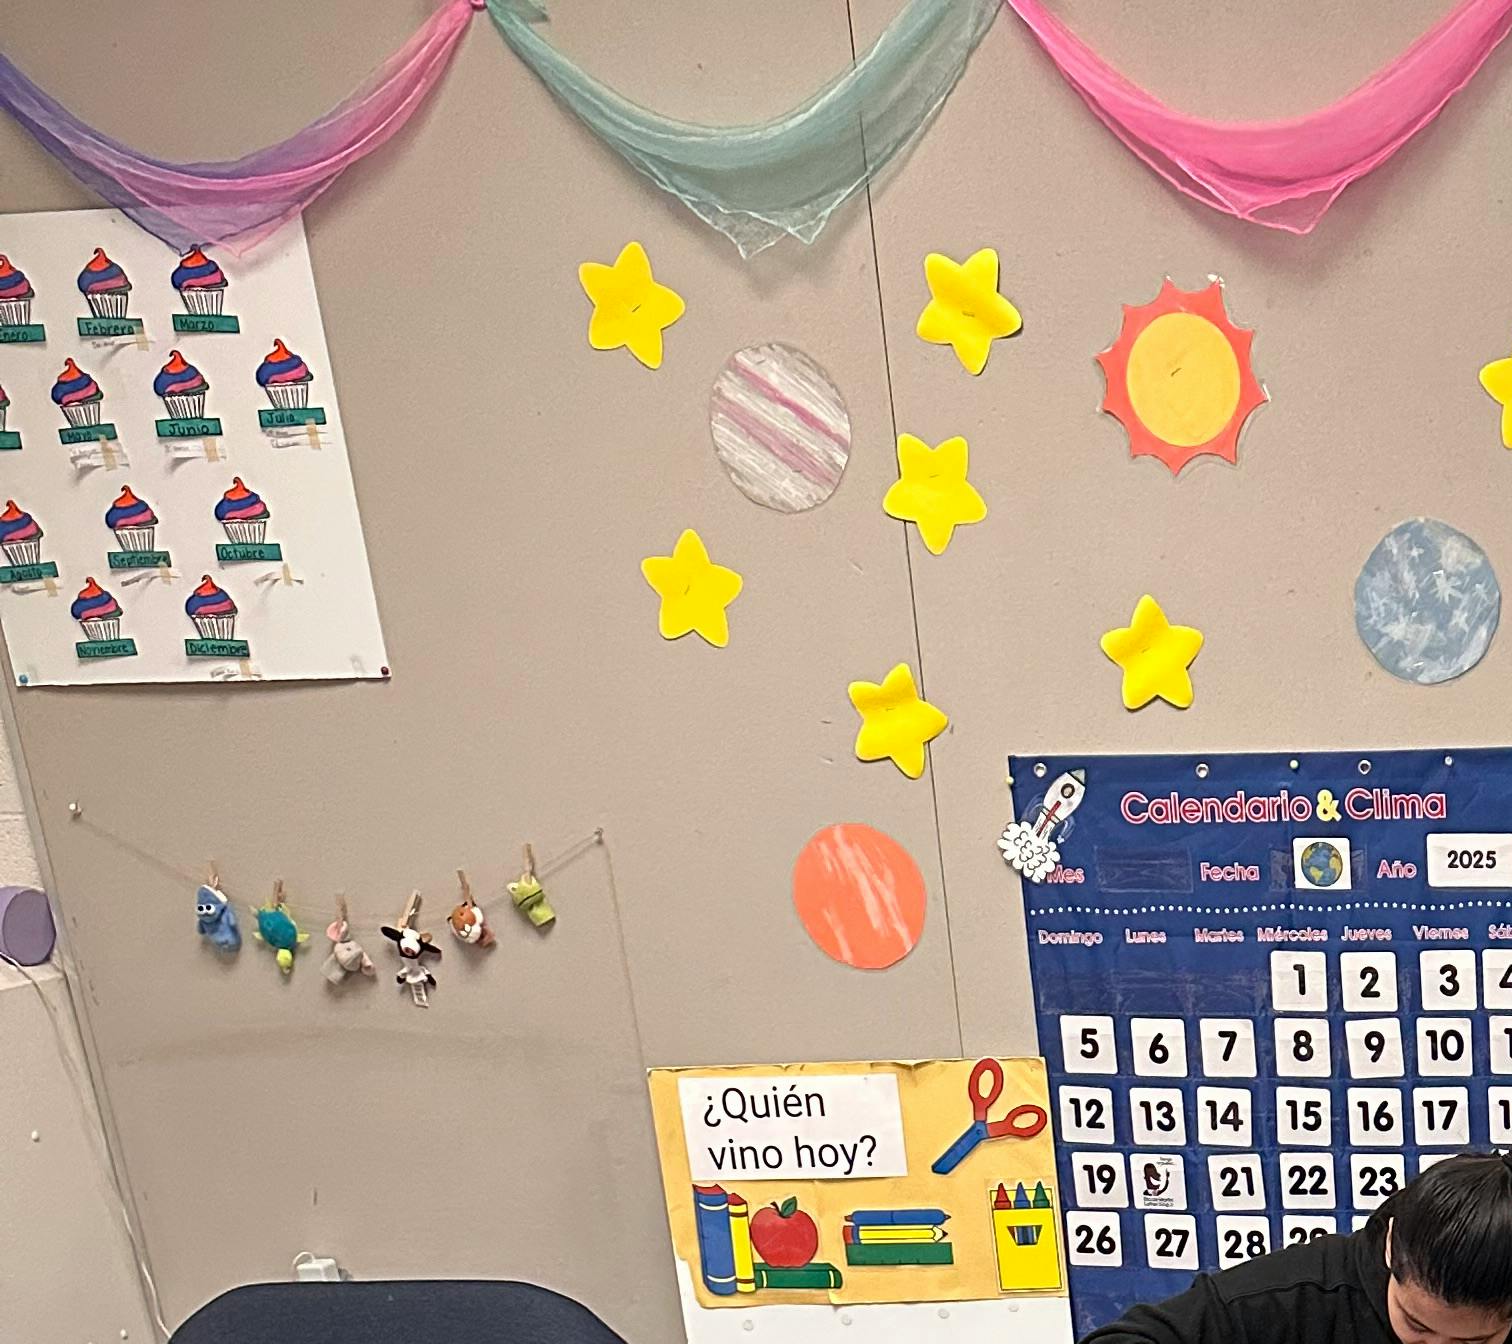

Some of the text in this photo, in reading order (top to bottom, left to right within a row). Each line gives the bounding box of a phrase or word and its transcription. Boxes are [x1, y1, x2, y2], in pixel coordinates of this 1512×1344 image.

[86, 321, 134, 336] Febrero
[179, 319, 214, 331] Marzo
[169, 424, 210, 435] Junio
[266, 412, 295, 424] Julio
[221, 548, 265, 560] Octubre
[1120, 787, 1447, 825] Calendario & Clima
[1377, 857, 1418, 880] Año
[1447, 849, 1497, 869] 2025
[1200, 861, 1260, 883] Fecha
[1038, 928, 1104, 947] Domingo
[1125, 928, 1167, 944] Lunes
[1194, 927, 1245, 943] Martes
[1257, 925, 1328, 942] Miércoles
[1341, 925, 1393, 941] Jueves
[1412, 925, 1469, 941] Viernes
[1292, 963, 1306, 996] 1
[1359, 966, 1381, 998] 2
[1439, 963, 1460, 997] 3
[1080, 1027, 1100, 1059] 5
[1148, 1032, 1169, 1065] 6
[1217, 1030, 1238, 1062] 7
[1292, 1029, 1314, 1062] 8
[1364, 1030, 1386, 1063] 9
[1425, 1029, 1465, 1062] 10
[703, 1084, 826, 1128] ¿Quién
[1068, 1097, 1106, 1130] 12
[1139, 1100, 1176, 1132] 13
[1205, 1099, 1244, 1132] 14
[1285, 1099, 1322, 1132] 15
[1356, 1100, 1394, 1132] 16
[1421, 1099, 1458, 1131] 17
[707, 1134, 877, 1174] vino hoy?
[1082, 1164, 1399, 1197] 19 21 22 23
[1075, 1224, 1116, 1255] 26
[1154, 1227, 1190, 1258] 27
[1224, 1230, 1266, 1259] 28
